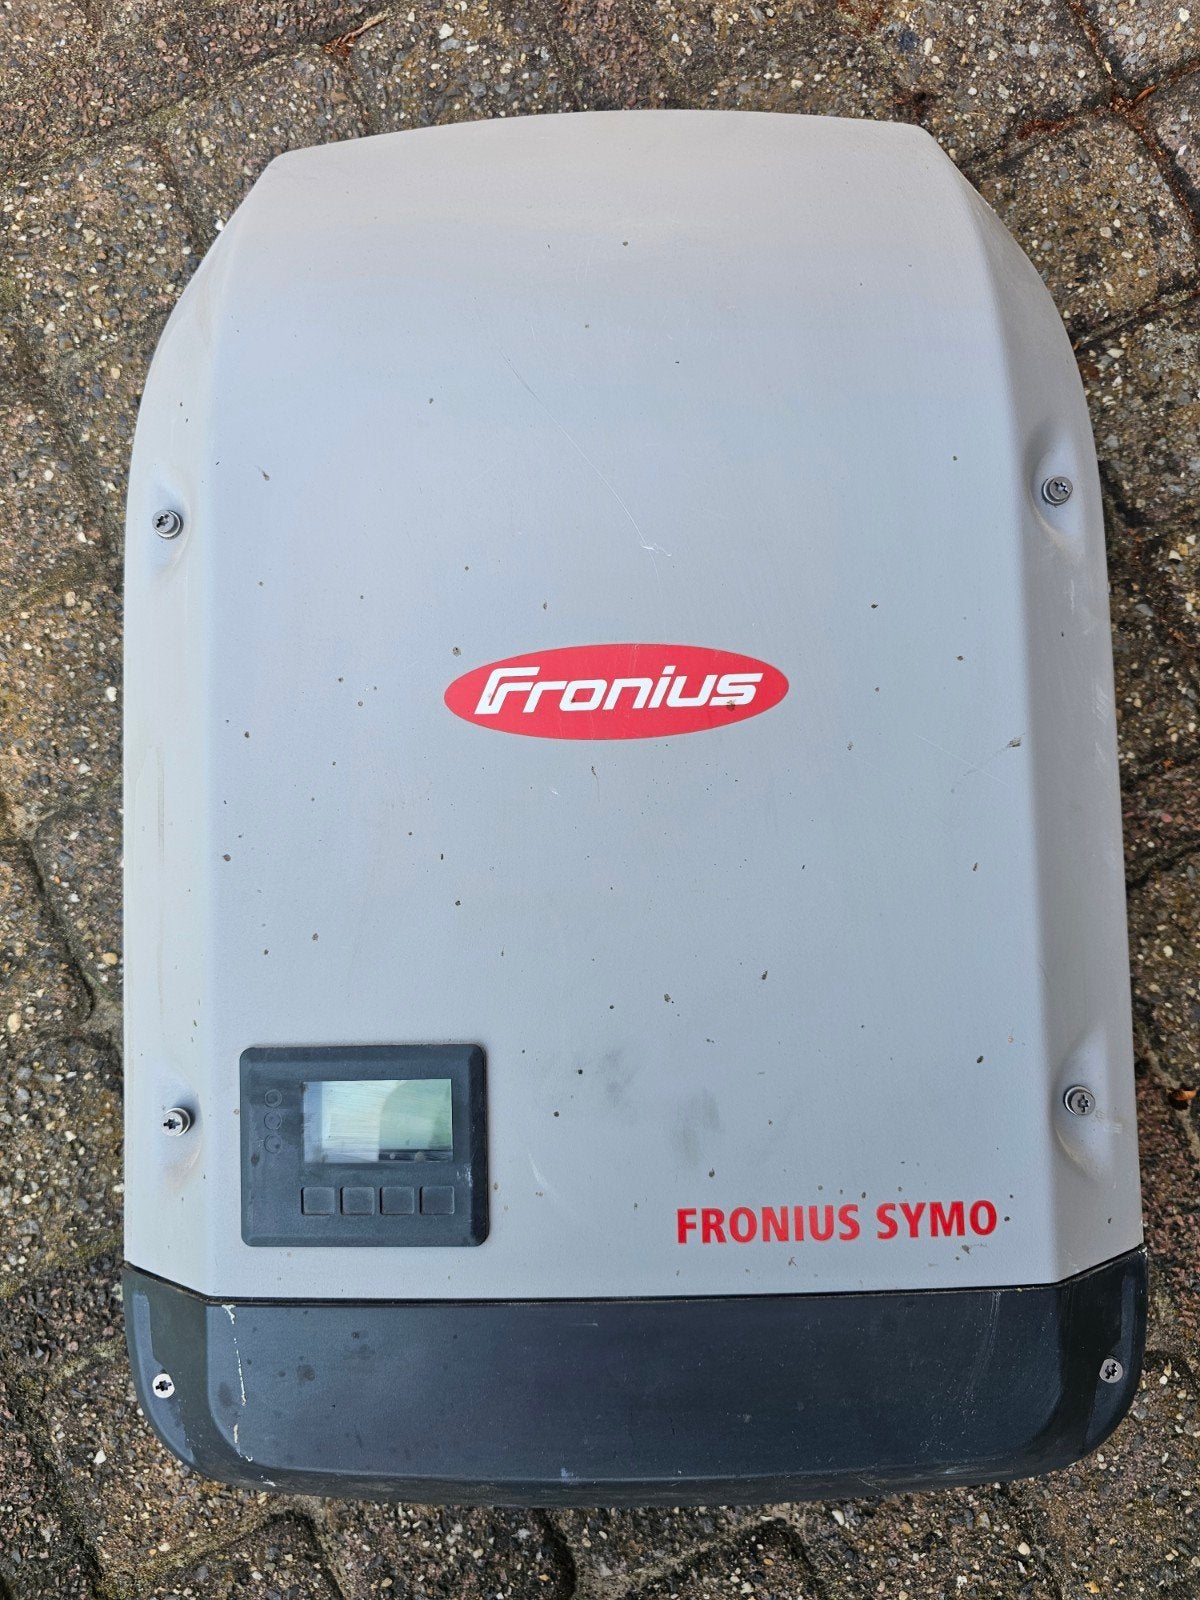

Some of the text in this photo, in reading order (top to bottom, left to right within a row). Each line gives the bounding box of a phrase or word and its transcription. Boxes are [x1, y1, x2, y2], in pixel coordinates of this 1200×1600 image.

[474, 665, 764, 715] Fronius
[676, 1199, 998, 1245] FRONIUS SYMO
